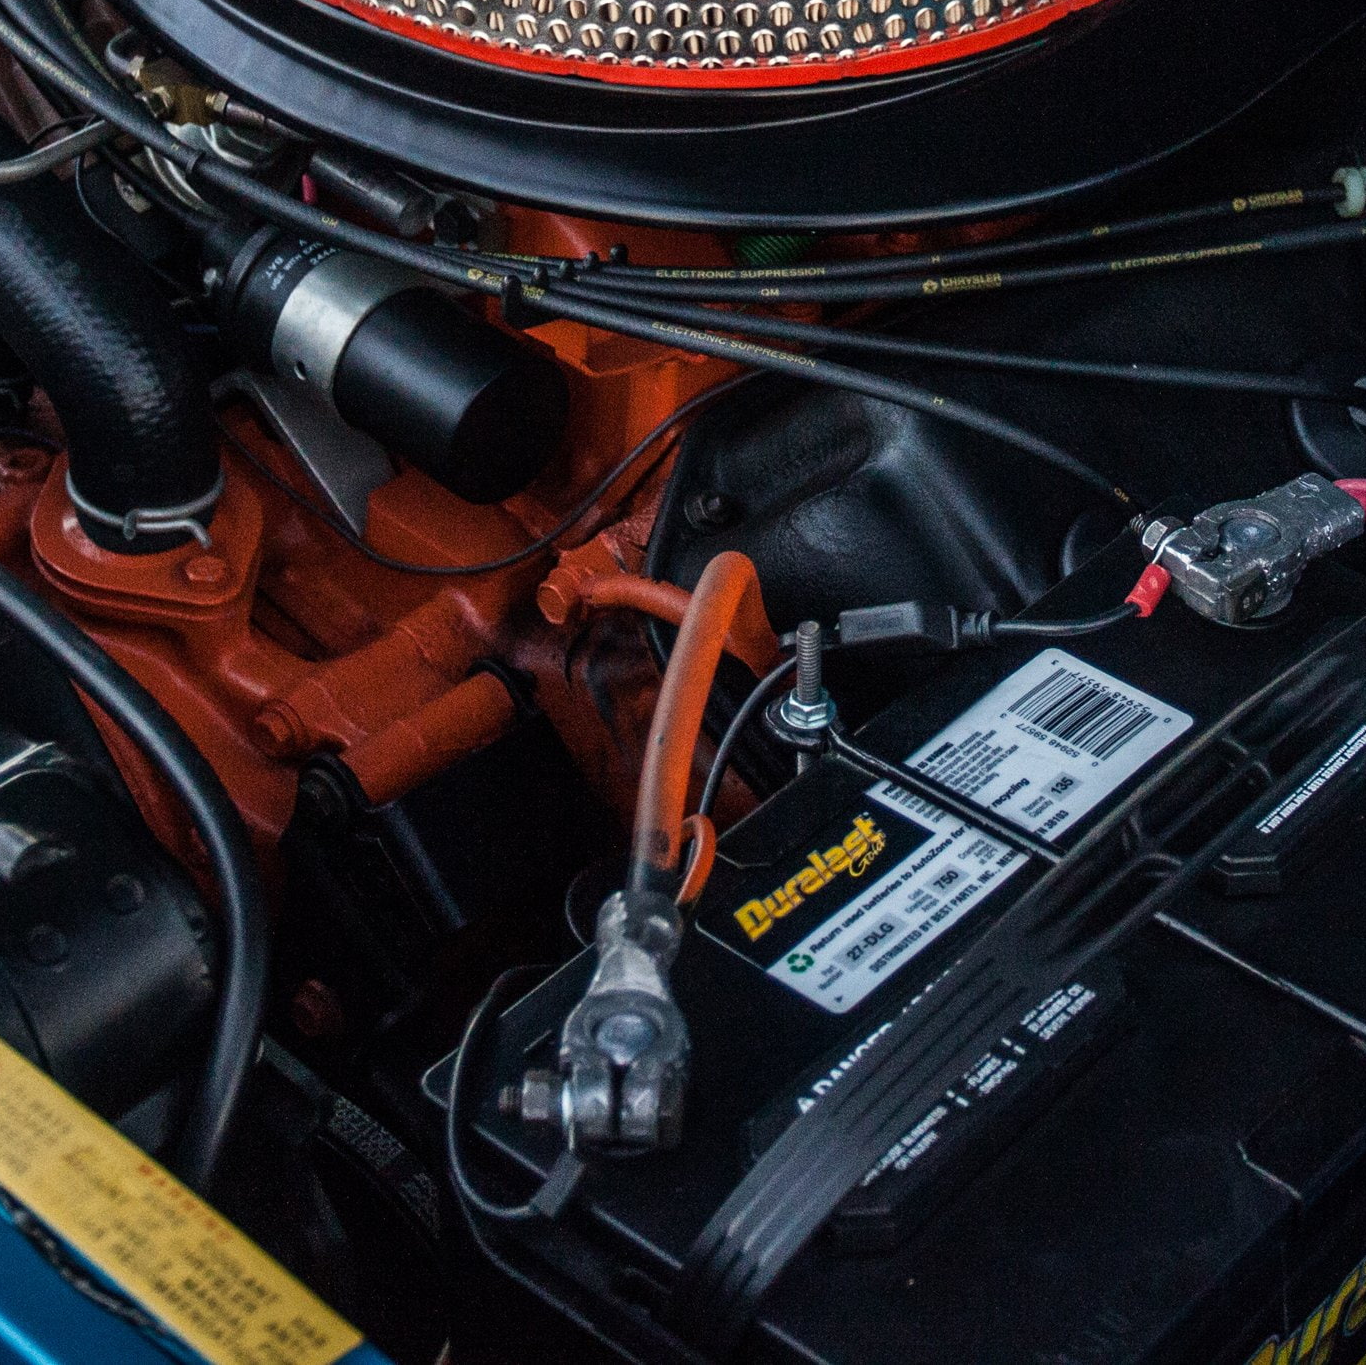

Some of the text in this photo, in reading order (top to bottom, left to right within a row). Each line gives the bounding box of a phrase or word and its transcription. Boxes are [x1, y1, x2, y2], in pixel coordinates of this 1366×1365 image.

[655, 268, 735, 279] ELECTRONIC
[739, 266, 826, 279] SUPPRESSION
[1111, 252, 1183, 271] ELECTRONIC
[651, 320, 727, 346] ELECTRONIC
[729, 339, 818, 369] SUPPRESSION
[1014, 720, 1049, 742] 59577
[1046, 736, 1081, 759] 52948
[988, 776, 1032, 809] recycling
[1047, 775, 1076, 796] 135
[1042, 808, 1071, 830] 38103
[848, 829, 888, 879] Gold
[734, 814, 885, 942] Duralast
[807, 825, 967, 954] Return used batteries to AutoZone for
[932, 868, 961, 890] 750
[866, 864, 1004, 973] DISTRIBUTED BY BEST PARTS, INC.,
[844, 920, 897, 961] 27-DLG
